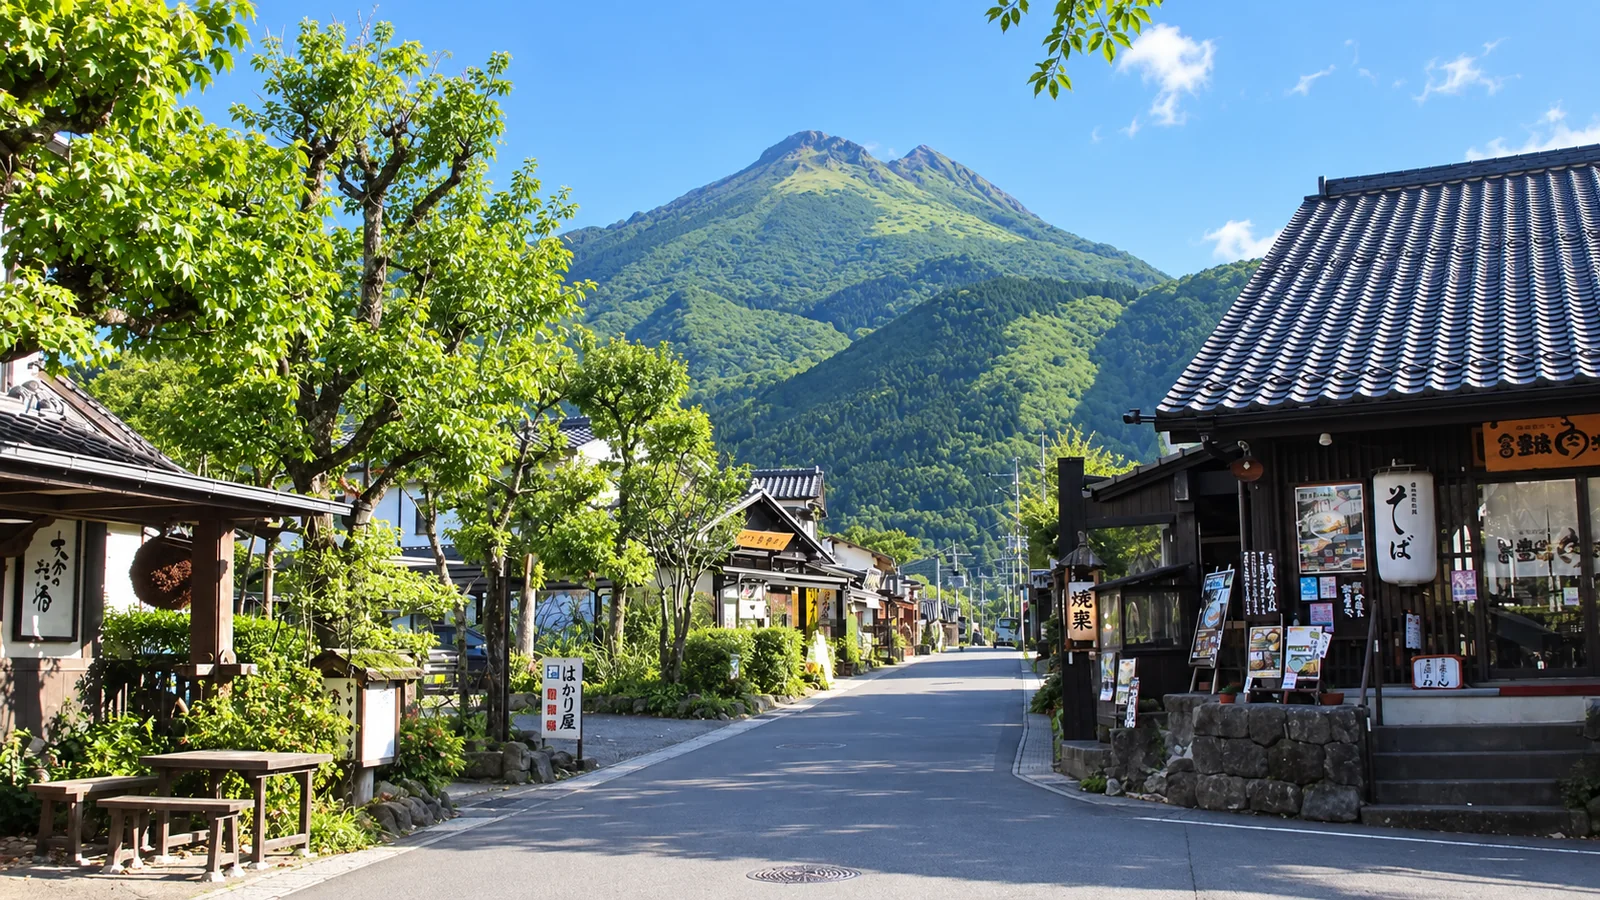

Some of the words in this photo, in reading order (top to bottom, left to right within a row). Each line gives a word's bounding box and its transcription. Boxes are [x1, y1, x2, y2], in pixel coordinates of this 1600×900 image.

[1385, 484, 1414, 560] そば
[559, 665, 576, 730] はかり屋
